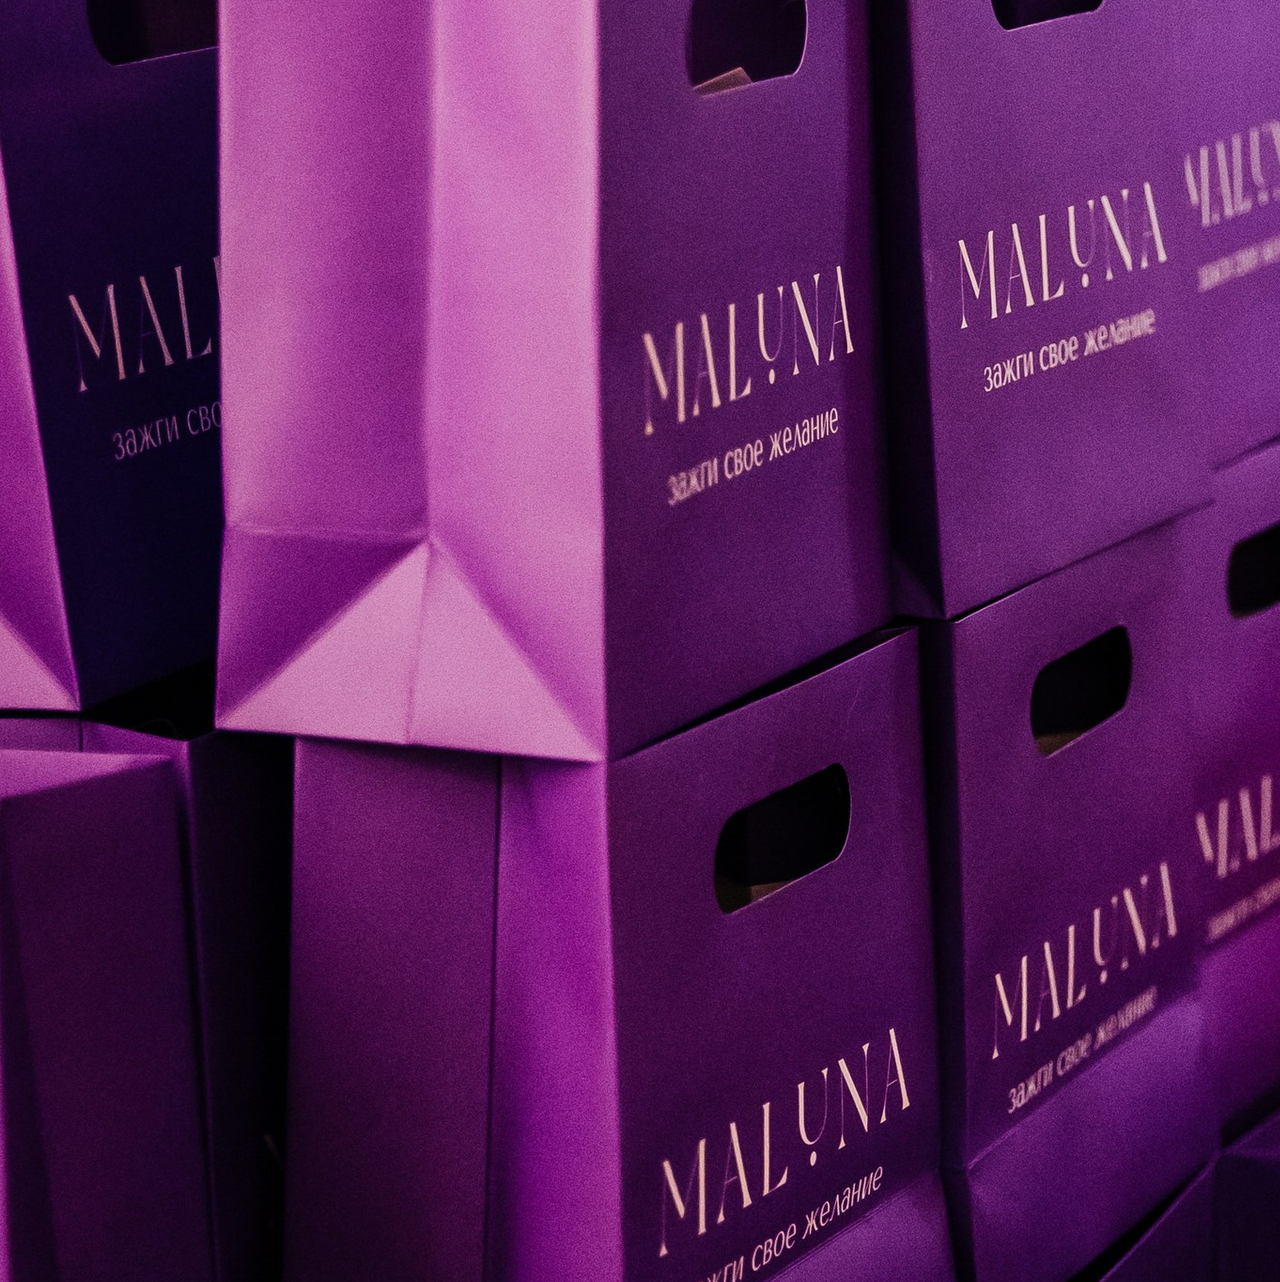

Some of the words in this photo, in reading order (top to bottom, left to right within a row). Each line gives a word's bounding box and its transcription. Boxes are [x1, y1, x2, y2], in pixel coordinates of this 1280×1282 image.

[958, 181, 1168, 330] MALUNA
[68, 255, 220, 393] MAL
[642, 265, 854, 436] MALUNA
[983, 350, 1035, 392] зажги
[1039, 335, 1079, 372] свое
[1083, 308, 1156, 356] желание
[112, 415, 180, 460] зажги
[186, 401, 221, 436] сво
[667, 456, 720, 506] зажги
[724, 438, 763, 479] свое
[768, 407, 838, 461] желание
[992, 861, 1178, 1060] MALUNA
[659, 1027, 910, 1258] MALUNA
[1008, 1059, 1053, 1114] зажги
[751, 1222, 797, 1273] свое
[801, 1165, 884, 1241] желание
